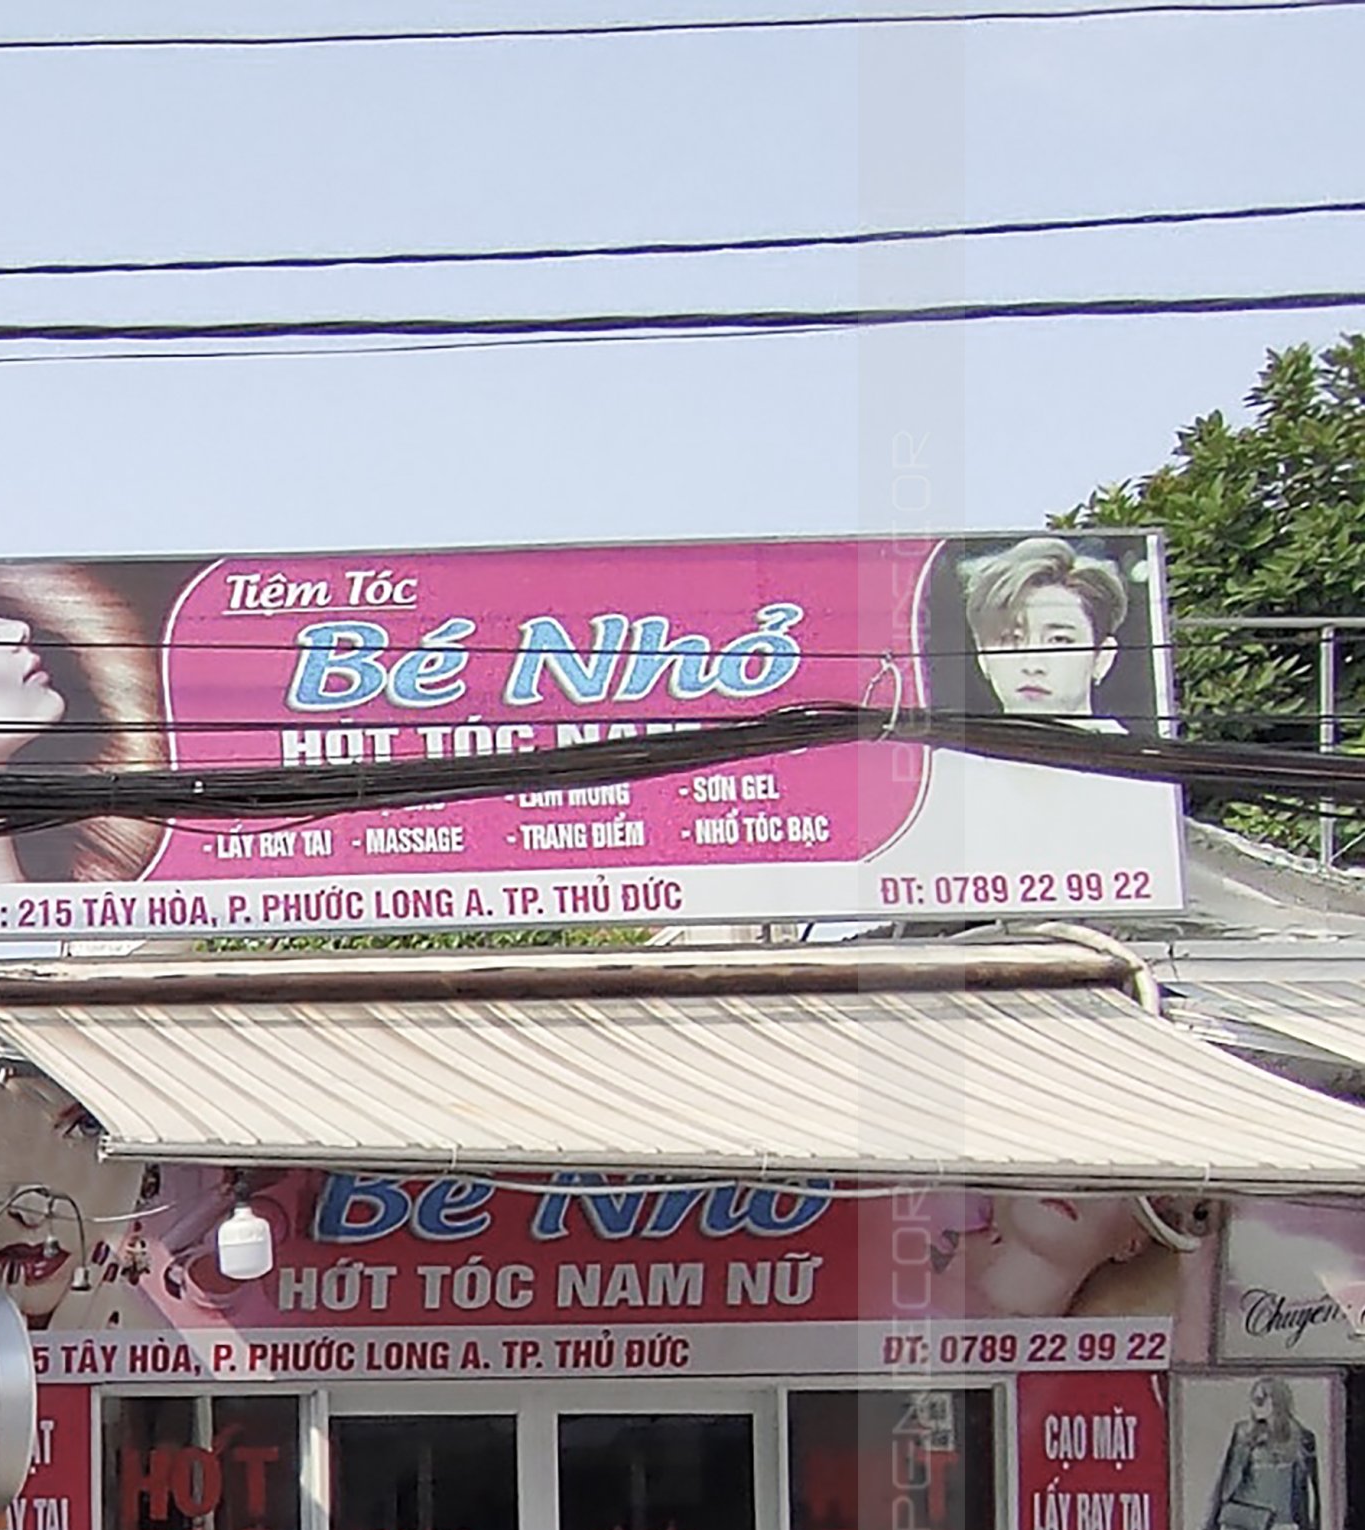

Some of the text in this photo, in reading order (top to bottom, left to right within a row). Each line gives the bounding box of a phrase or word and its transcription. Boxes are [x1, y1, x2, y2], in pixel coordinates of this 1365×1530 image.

[345, 570, 418, 606] Tóc
[286, 602, 804, 712] Bé Nhỏ
[417, 715, 536, 760] TÓC
[692, 774, 780, 802] SƠN GEL
[216, 819, 332, 859] LẤY RAY TAI
[366, 826, 465, 855] MASSAGE
[520, 811, 645, 850] TRANG ĐIỂM
[744, 811, 784, 843] TÓC
[787, 815, 830, 848] BẠC
[18, 898, 72, 928] 215
[82, 891, 137, 928] TÂY
[148, 888, 219, 928] HÒA,
[228, 895, 251, 924] P.
[262, 884, 365, 923] PHƯỚC
[374, 887, 455, 920] LONG
[465, 888, 494, 917] A.
[501, 885, 545, 915] TP.
[553, 874, 611, 914] THỦ
[621, 875, 684, 912] ĐỨC
[880, 870, 1152, 905] ĐT: 0789 22 99 22
[277, 1250, 825, 1312] HỚT TÓC NAM NỮ
[61, 1328, 691, 1376] TÂY HÒA, P. PHƯỚC LONG A. TP. THỦ ĐỨC
[882, 1332, 1168, 1365] ĐT: 0789 22 99 22
[1045, 1406, 1138, 1470] CẠO MẶT
